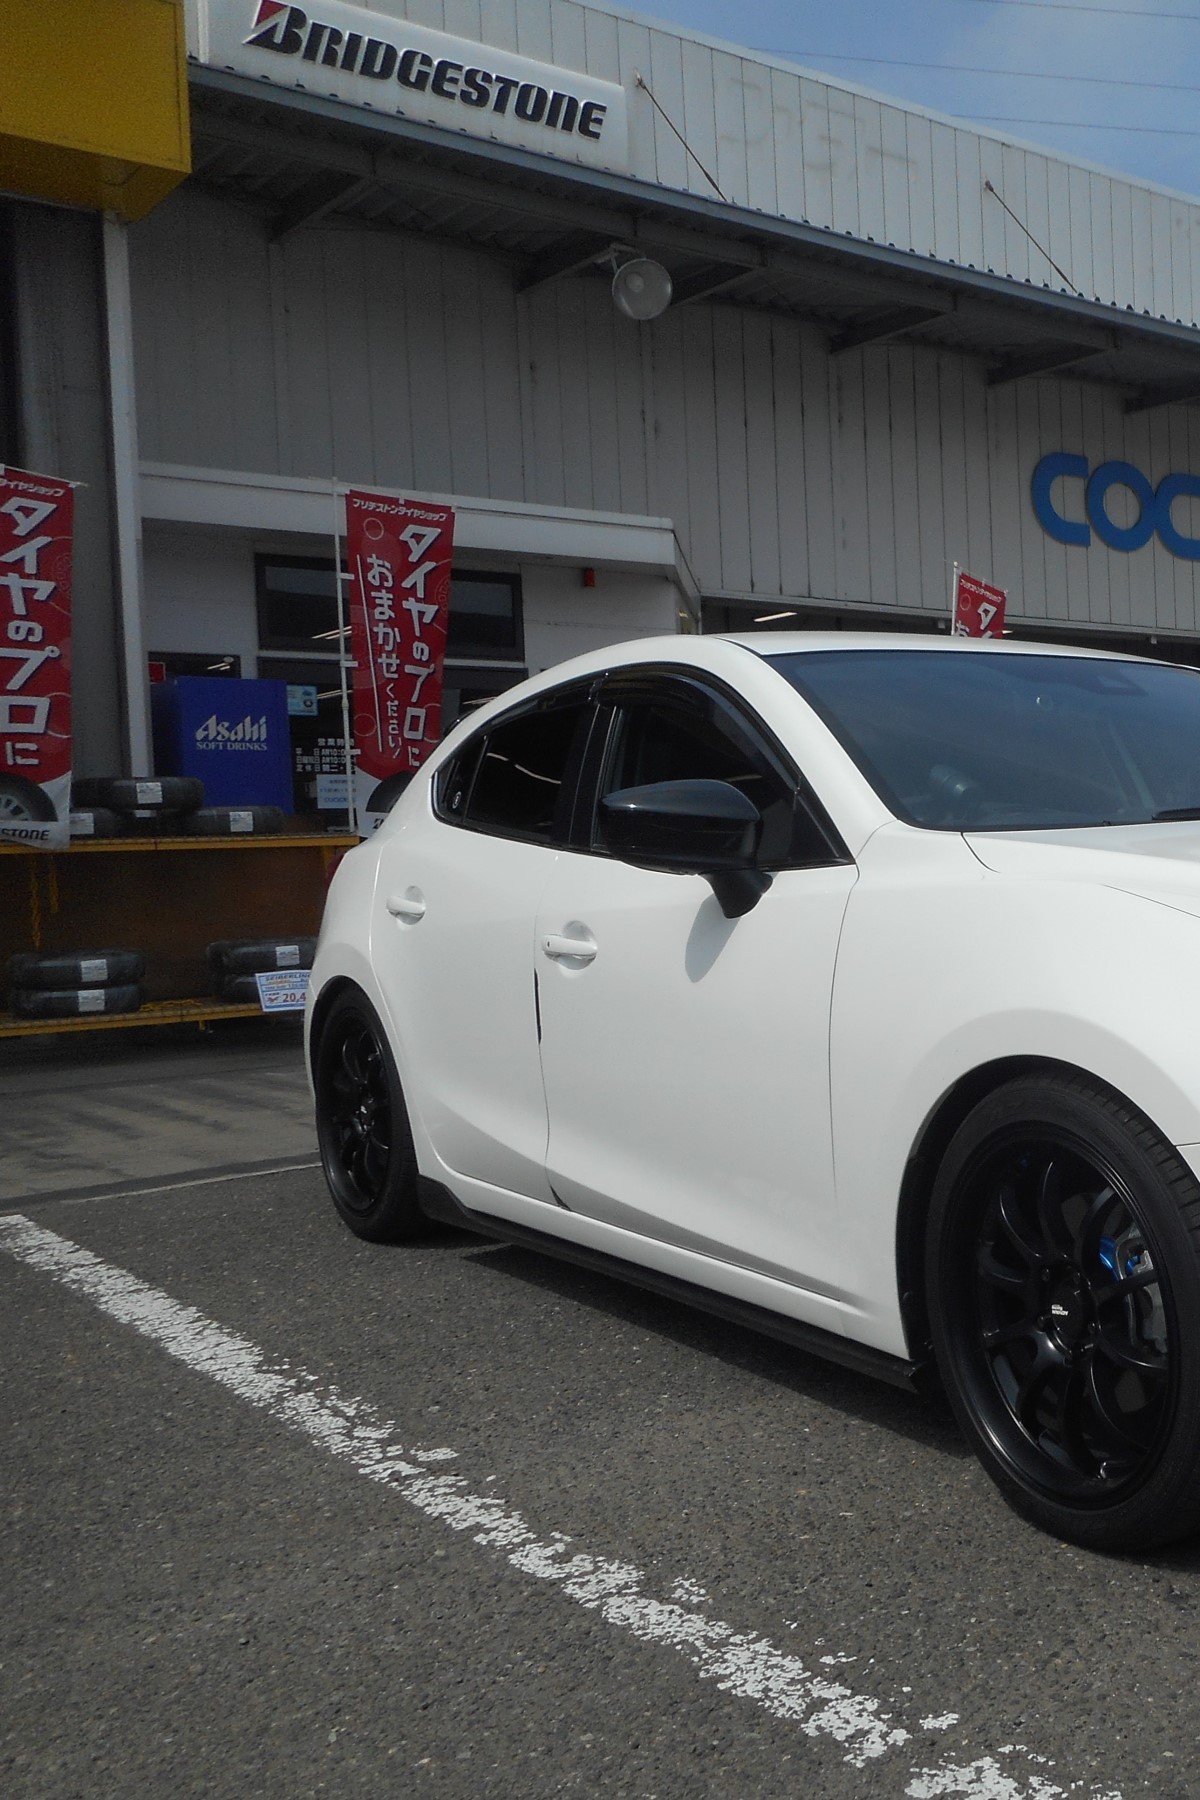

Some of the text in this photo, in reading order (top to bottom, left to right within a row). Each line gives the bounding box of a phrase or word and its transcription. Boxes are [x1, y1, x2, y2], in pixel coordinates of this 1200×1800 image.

[242, 0, 608, 139] BRIDGESTONE
[0, 496, 61, 767] タイヤのプロに
[399, 523, 442, 768] タイヤのプロに
[195, 714, 267, 742] Asahi
[196, 741, 268, 751] SOFT DRINKS
